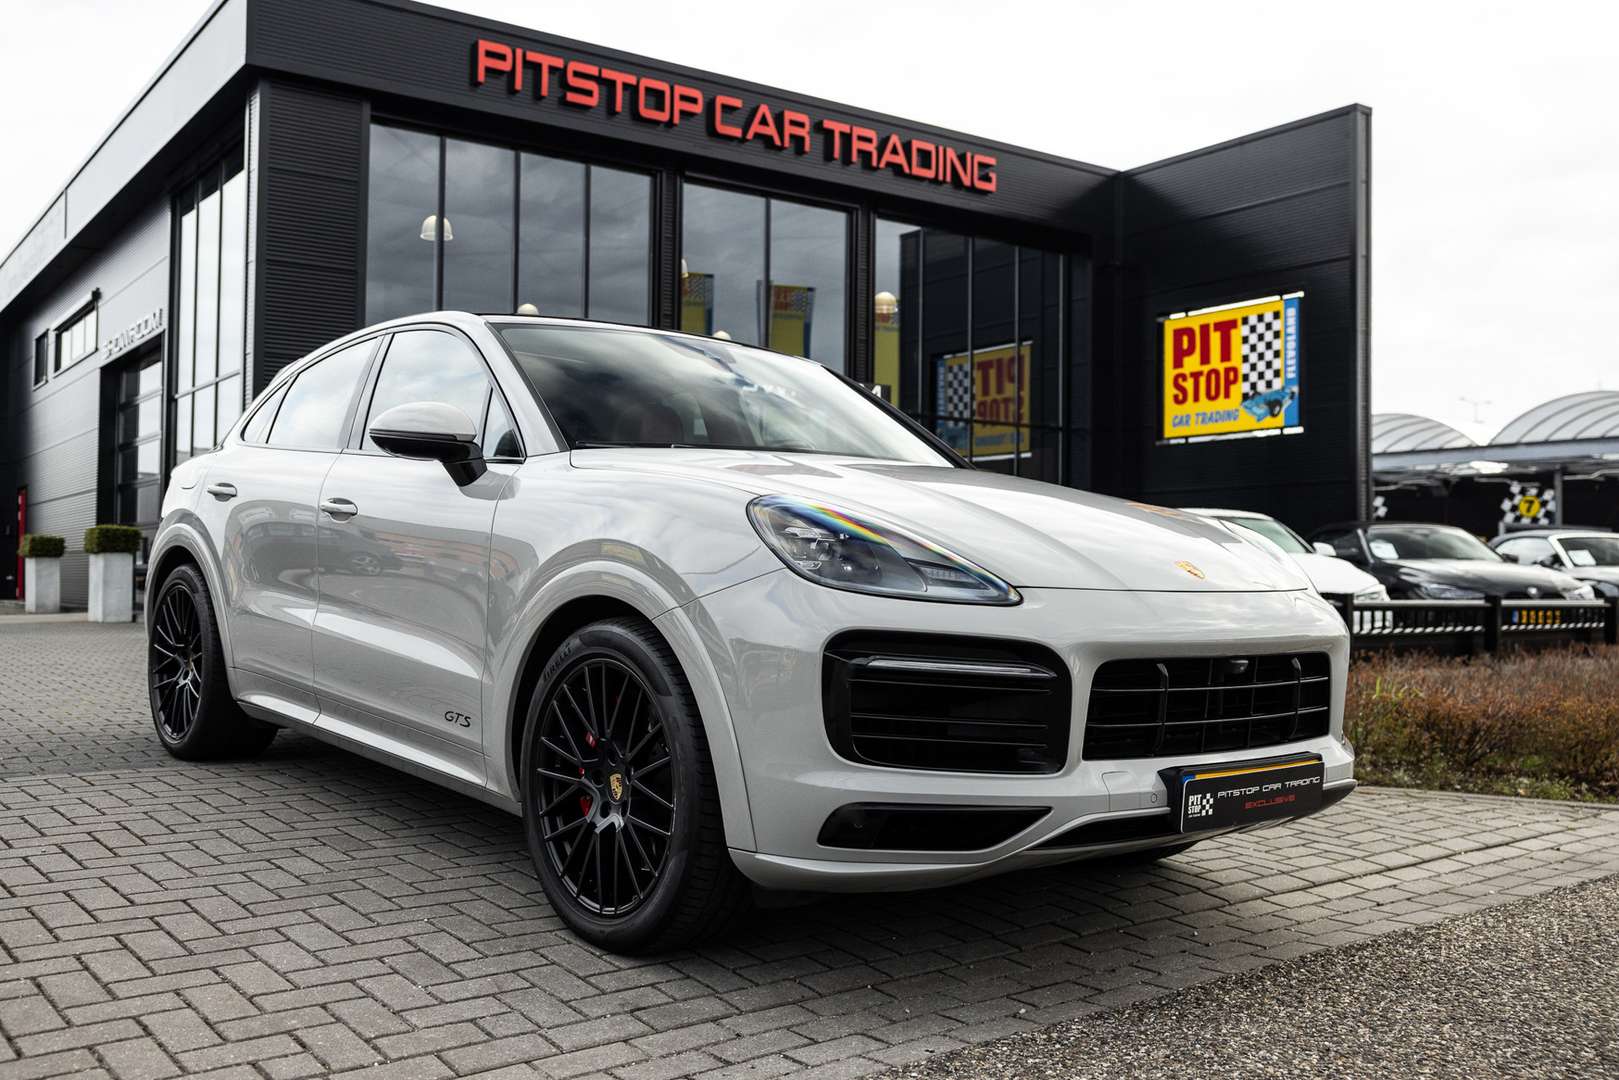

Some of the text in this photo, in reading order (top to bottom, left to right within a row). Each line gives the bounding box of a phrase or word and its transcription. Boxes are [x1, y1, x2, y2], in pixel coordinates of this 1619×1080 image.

[475, 39, 997, 193] PITSTOP CAR TRADING
[1172, 318, 1239, 370] PIT
[1172, 366, 1239, 406] STOP
[1171, 408, 1240, 428] CAR TRADING
[1524, 500, 1534, 513] 7
[444, 710, 472, 728] GTS
[1217, 776, 1320, 799] PITSTOP CAR TRADING
[1188, 794, 1202, 806] PIT
[1188, 804, 1202, 814] STOP
[1245, 794, 1296, 809] EXCLUSIVE
